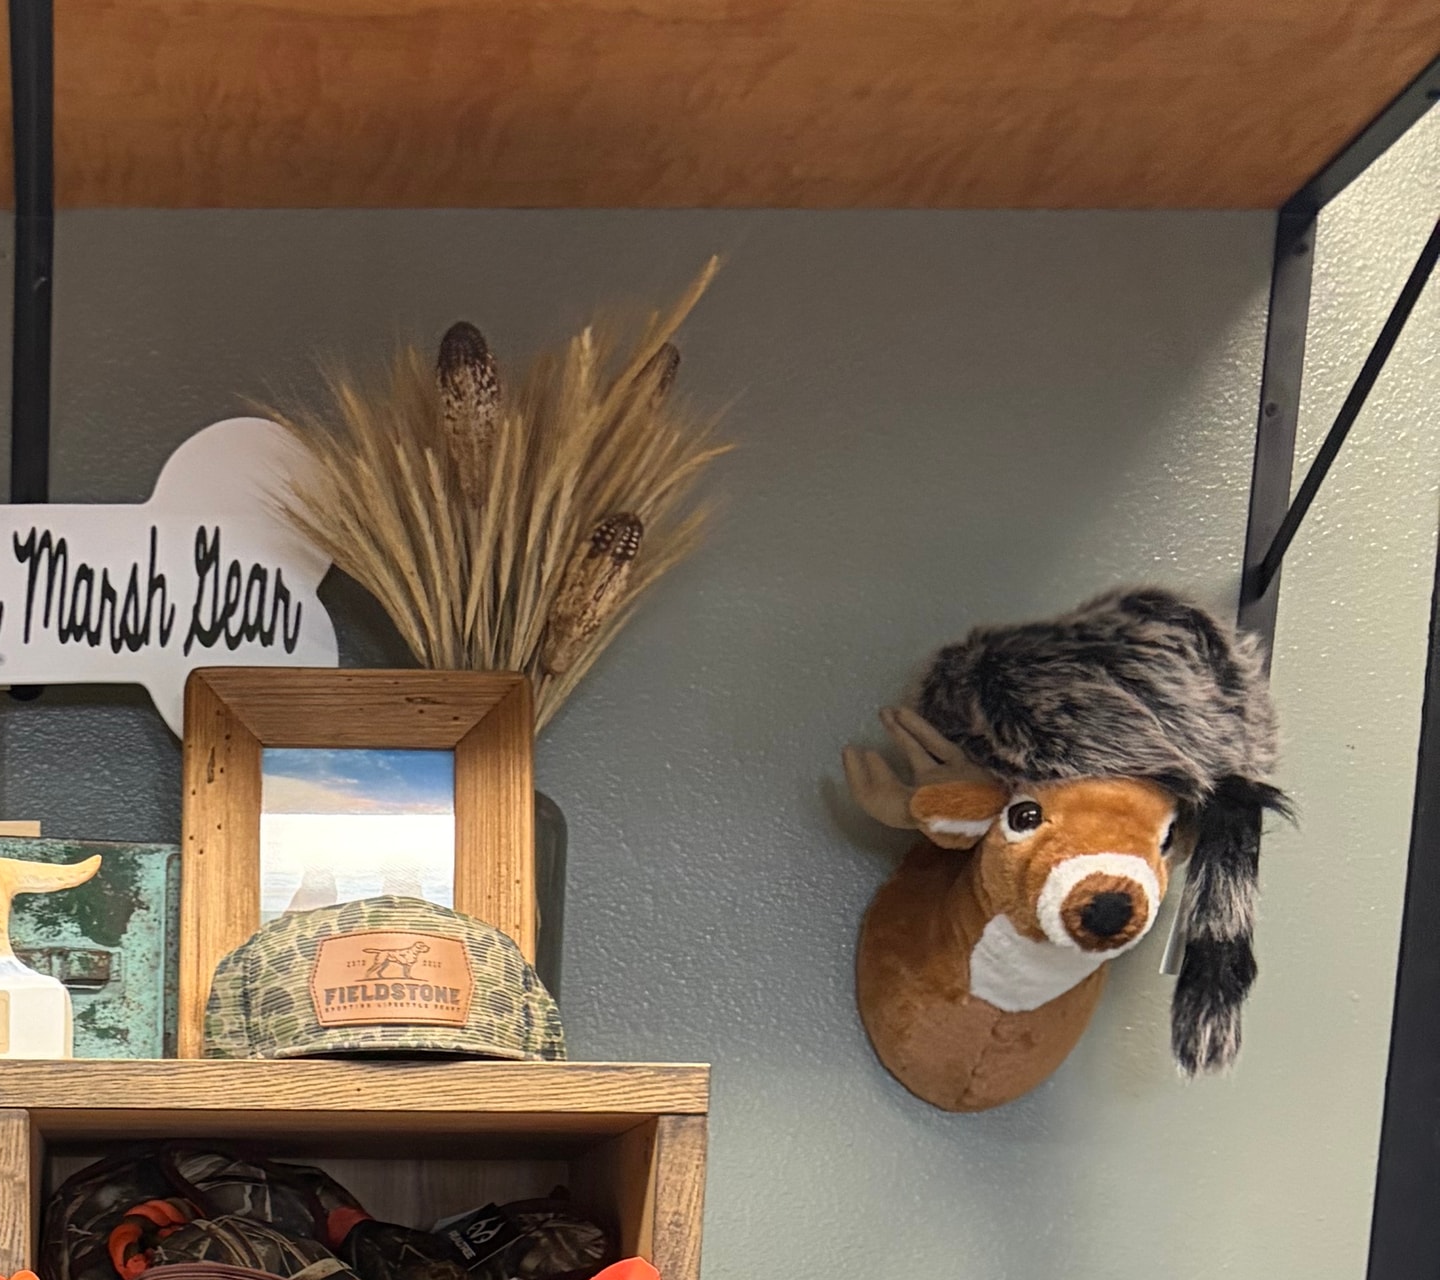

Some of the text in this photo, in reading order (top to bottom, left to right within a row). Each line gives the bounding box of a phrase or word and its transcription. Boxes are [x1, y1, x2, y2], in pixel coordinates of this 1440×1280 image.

[13, 526, 175, 654] Marsh
[183, 526, 302, 656] Gear
[324, 983, 461, 1006] FIELDSTONE
